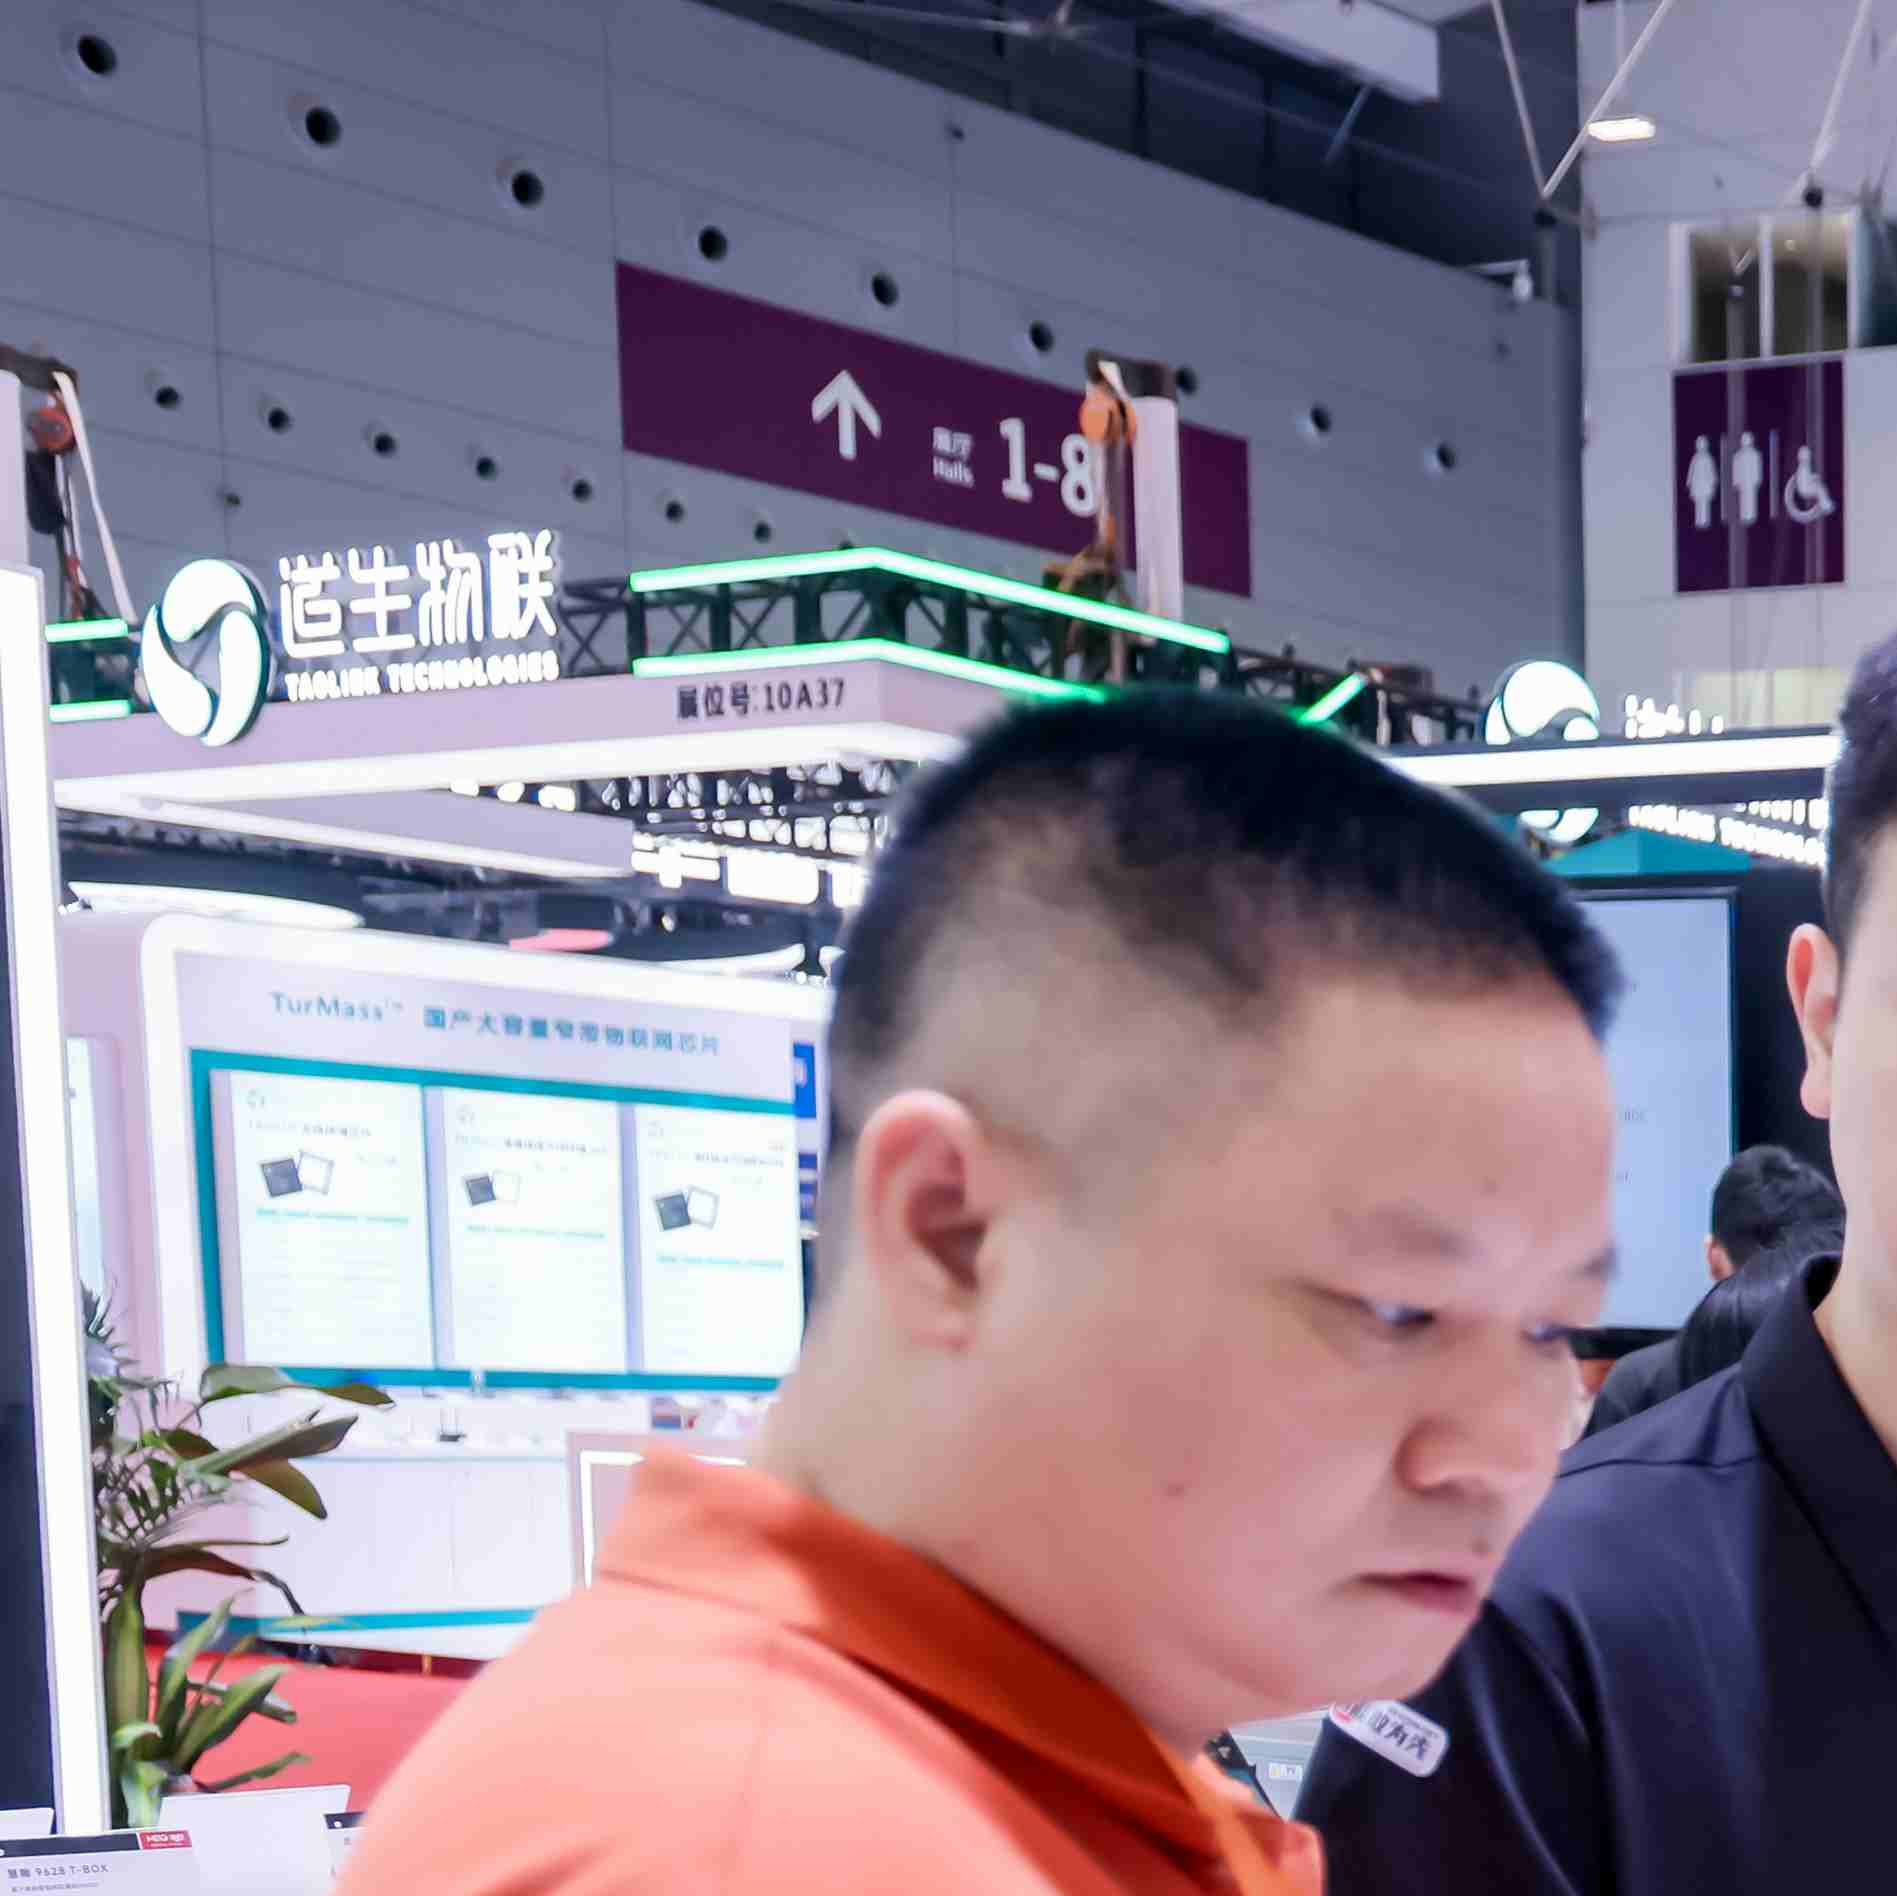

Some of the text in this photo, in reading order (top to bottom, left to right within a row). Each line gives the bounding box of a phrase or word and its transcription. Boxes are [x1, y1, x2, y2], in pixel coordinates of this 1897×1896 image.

[999, 416, 1101, 517] 1-8
[676, 680, 847, 721] 展位号:10A37
